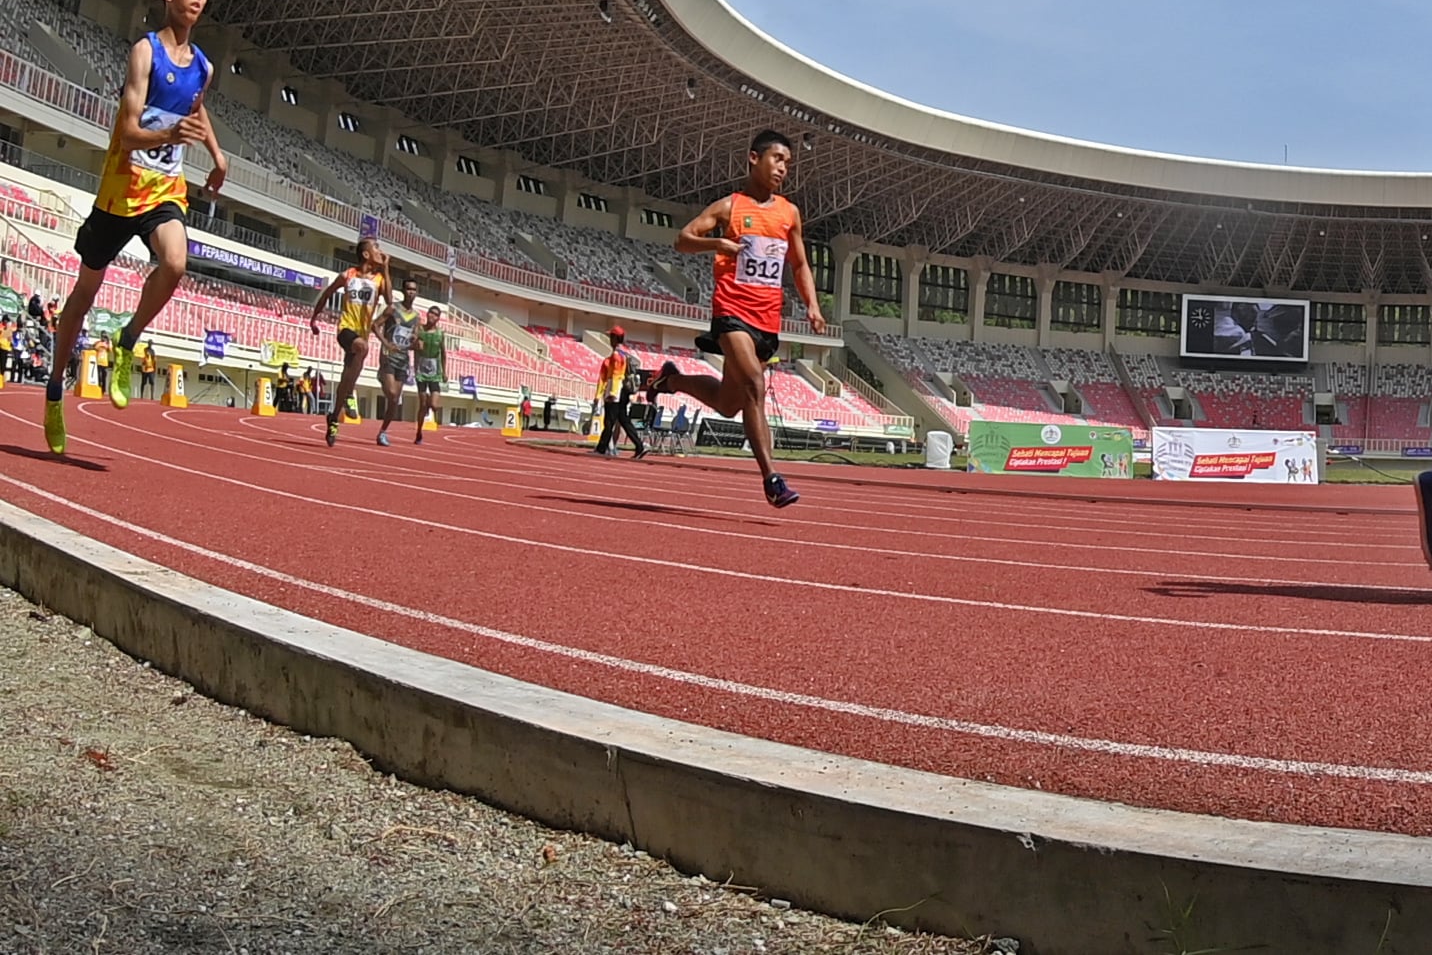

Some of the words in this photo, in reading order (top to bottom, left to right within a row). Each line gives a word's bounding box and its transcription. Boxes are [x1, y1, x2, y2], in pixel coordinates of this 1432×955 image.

[201, 245, 239, 265] PEPARNAS
[240, 257, 260, 272] PAPUA
[262, 263, 272, 275] XVI
[745, 258, 780, 279] 512
[350, 289, 372, 301] 300
[89, 361, 95, 380] 7
[177, 374, 183, 390] 6
[265, 386, 271, 400] 5
[507, 413, 515, 425] 2
[593, 421, 599, 432] 1
